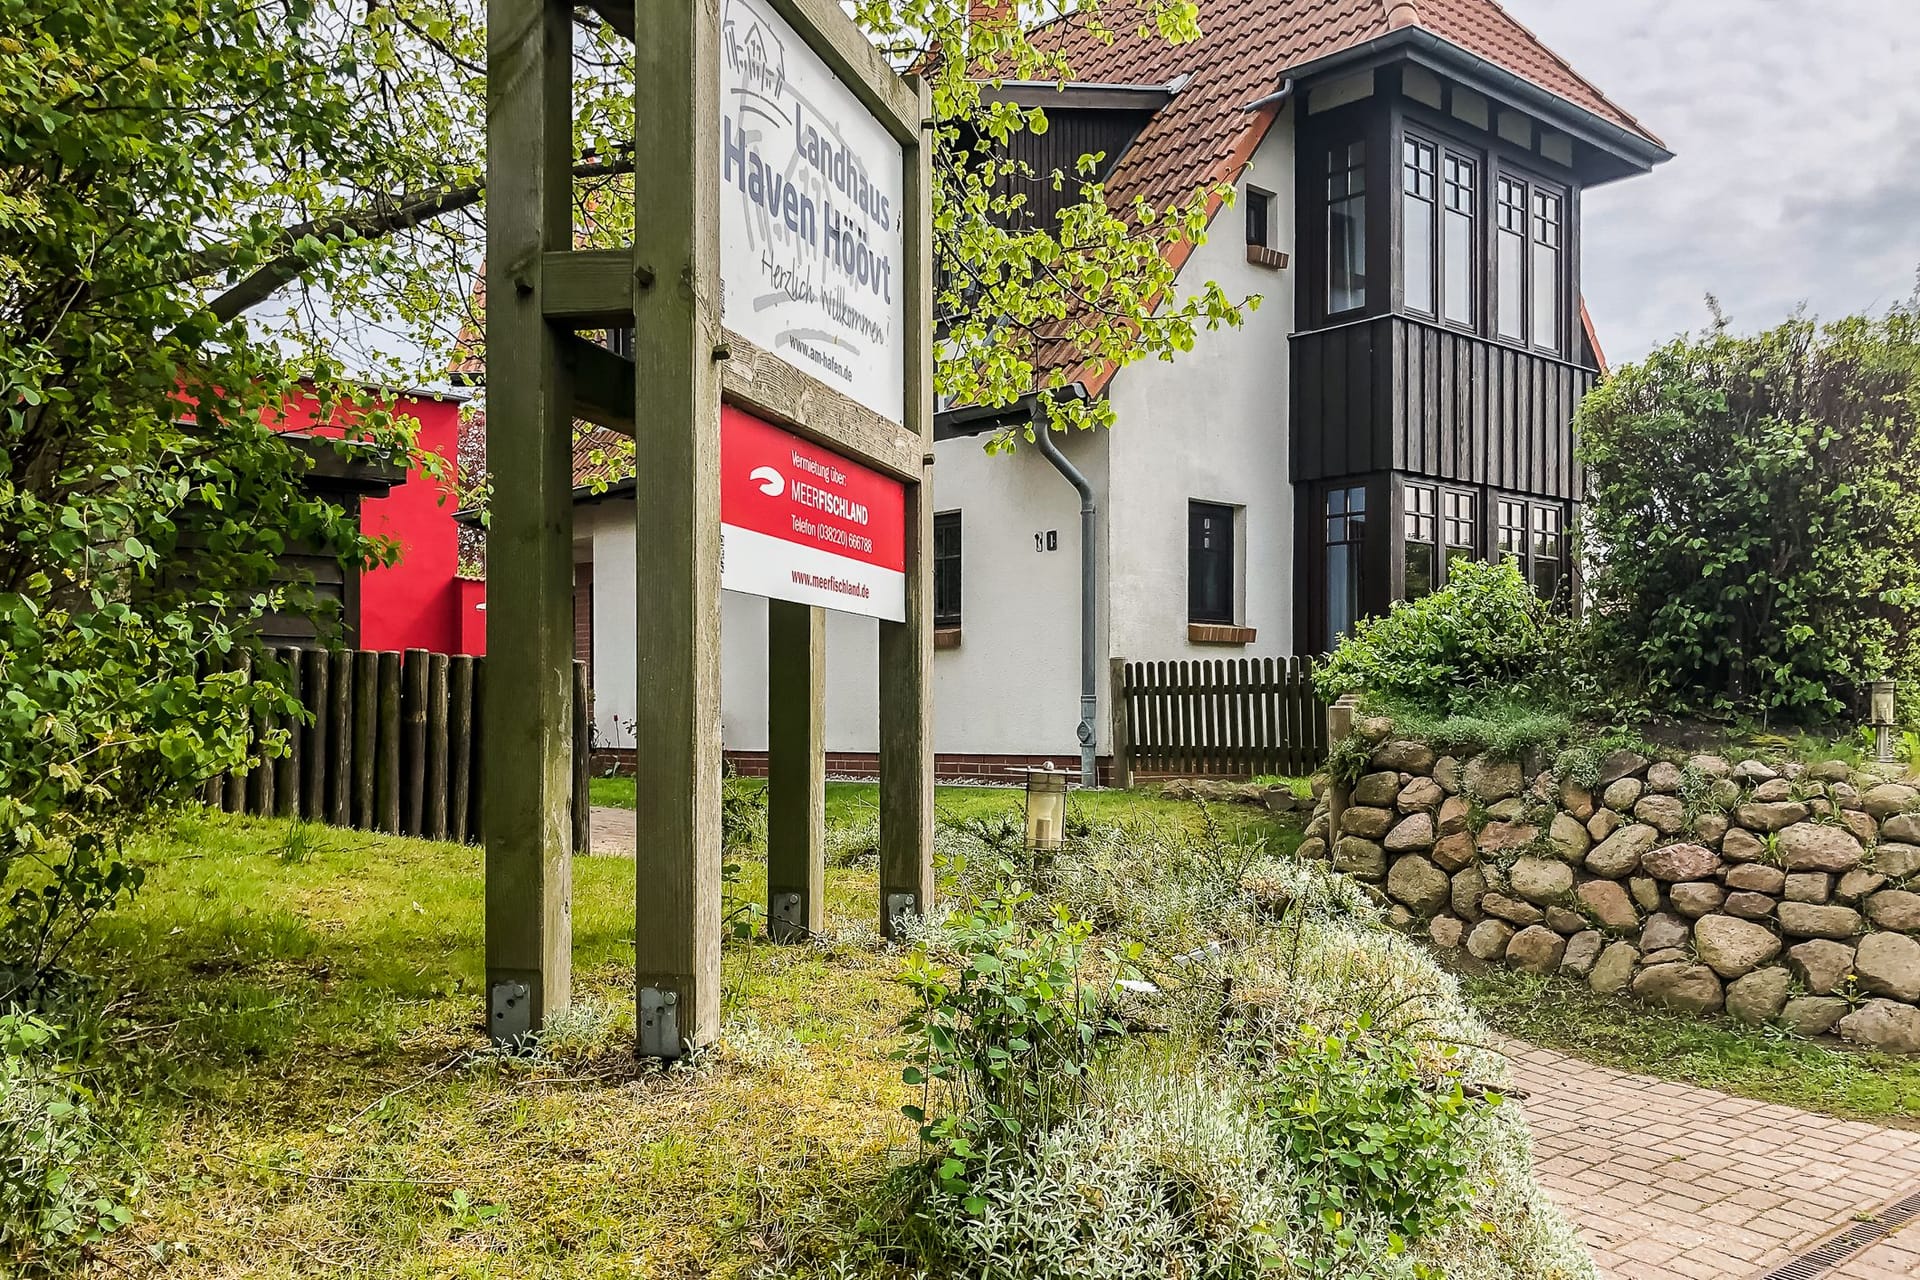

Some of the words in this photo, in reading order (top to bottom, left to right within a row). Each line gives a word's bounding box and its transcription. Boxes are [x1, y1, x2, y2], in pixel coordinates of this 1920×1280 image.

[796, 102, 890, 232] Landhaus
[724, 115, 815, 247] Haven
[824, 200, 891, 306] Höövt
[761, 249, 815, 304] Herzlich
[789, 334, 853, 382] www.am-hafen.de
[791, 449, 830, 483] Vermietung
[830, 466, 847, 487] über:
[791, 479, 868, 526] MEERFISCHLAND
[791, 514, 816, 537] Telefon
[817, 523, 848, 549] (038220)
[848, 533, 873, 554] 666788
[791, 569, 870, 599] www.meerfischland.de
